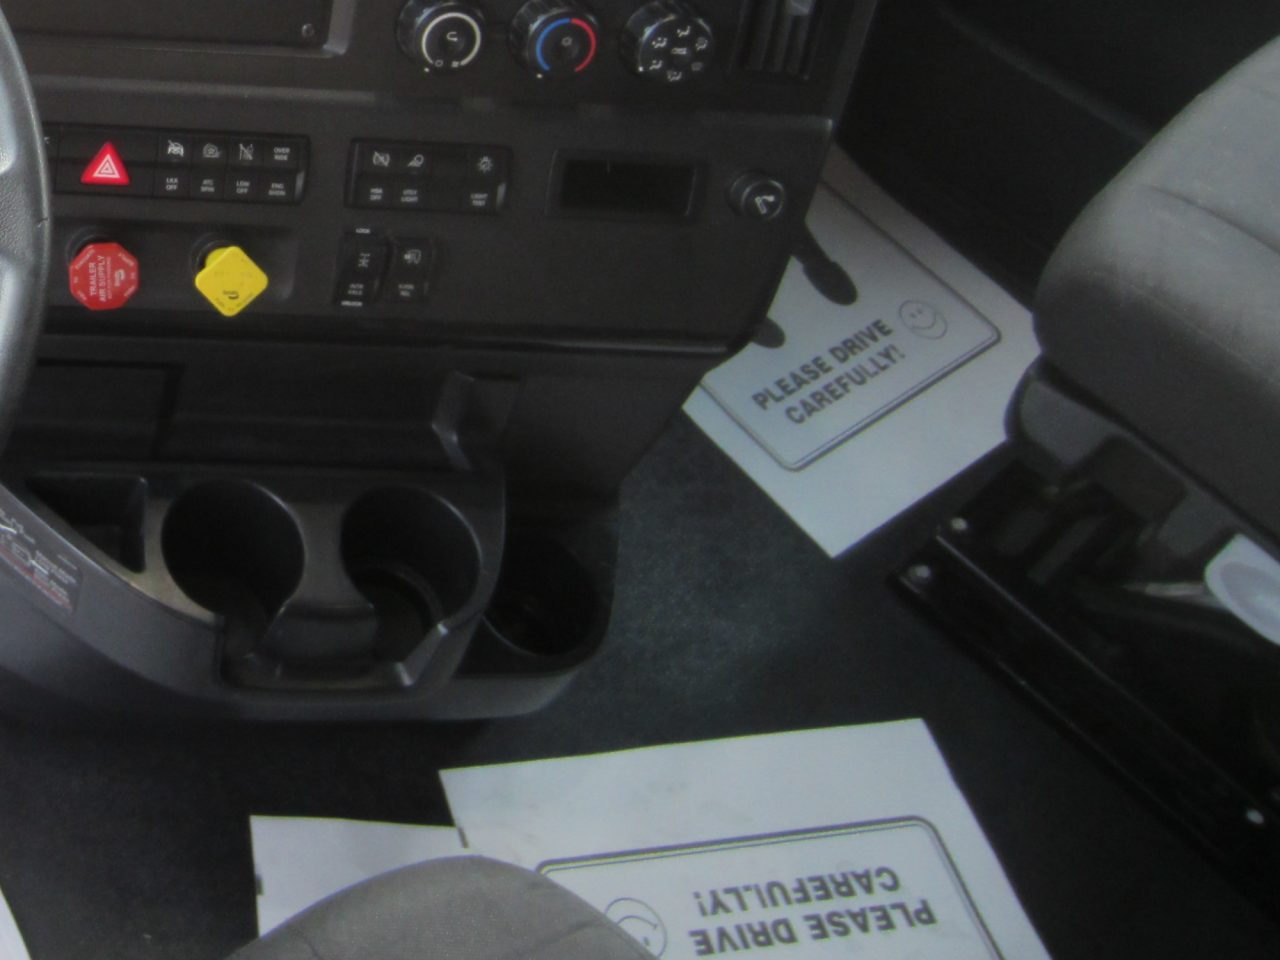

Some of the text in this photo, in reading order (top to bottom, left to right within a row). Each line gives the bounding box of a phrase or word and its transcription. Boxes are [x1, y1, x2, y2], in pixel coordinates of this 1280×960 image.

[88, 262, 97, 296] TRAILER
[97, 255, 106, 287] SUPPLY
[751, 318, 894, 411] PLEASE DRIVE
[784, 343, 907, 425] CAREFULLY!
[693, 866, 902, 917] CAREFULLY!
[688, 898, 938, 957] PLEASE DRIVE
